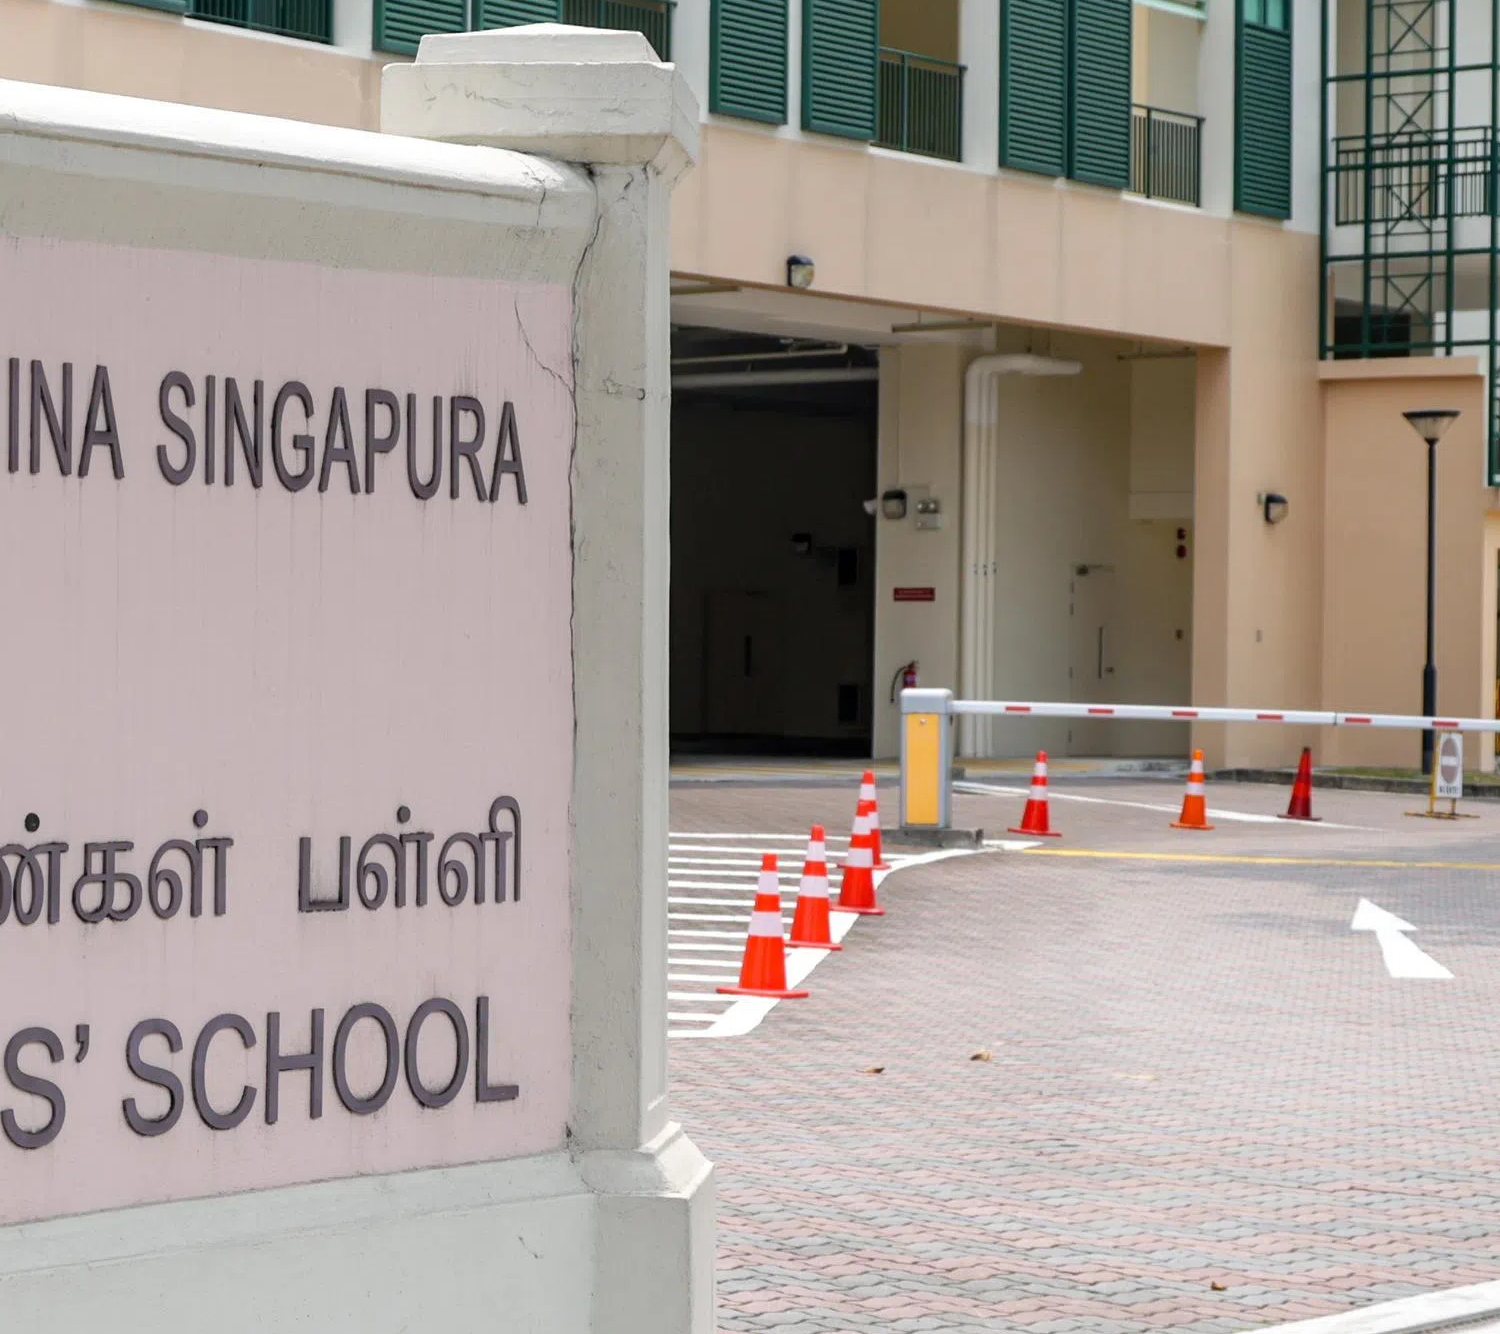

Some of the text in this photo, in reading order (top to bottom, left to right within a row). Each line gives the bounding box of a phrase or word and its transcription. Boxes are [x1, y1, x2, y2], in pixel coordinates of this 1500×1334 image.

[155, 370, 530, 506] SINGAPURA
[297, 794, 523, 915] பள்ளி
[121, 995, 521, 1138] SCHOOL
